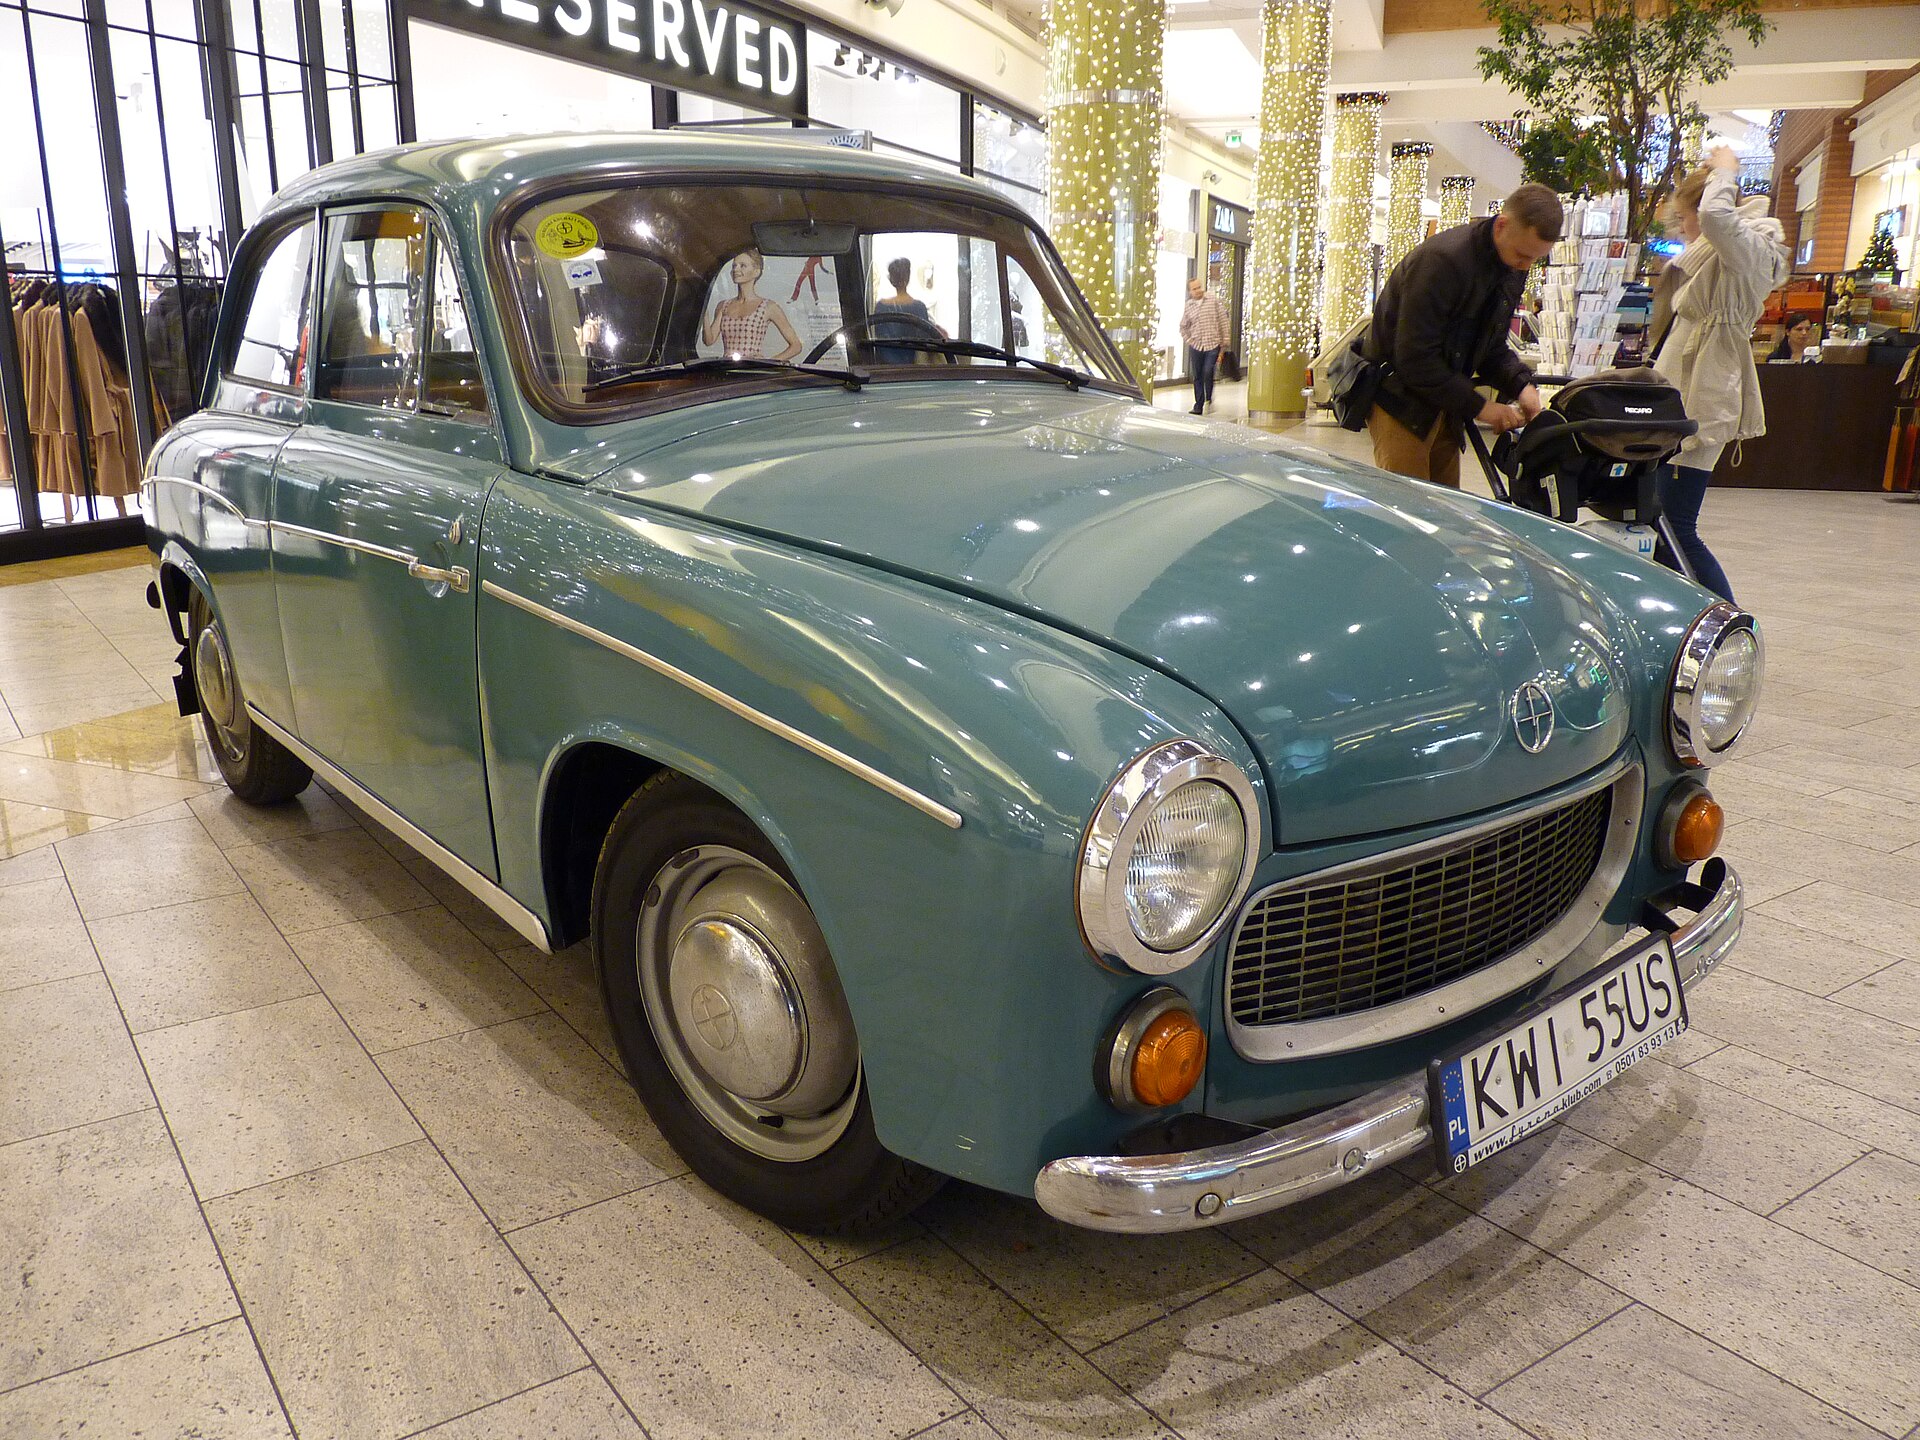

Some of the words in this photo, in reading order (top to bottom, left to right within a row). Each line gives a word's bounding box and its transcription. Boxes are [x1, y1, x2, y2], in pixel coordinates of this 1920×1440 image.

[1624, 406, 1653, 414] RECARO
[1470, 1016, 1563, 1131] KWI
[1579, 952, 1673, 1063] 55US
[1615, 1052, 1636, 1074] 0501
[1638, 1042, 1650, 1059] 83
[1650, 1034, 1662, 1051] 93
[1664, 1026, 1675, 1043] 13
[1448, 1116, 1466, 1141] PL
